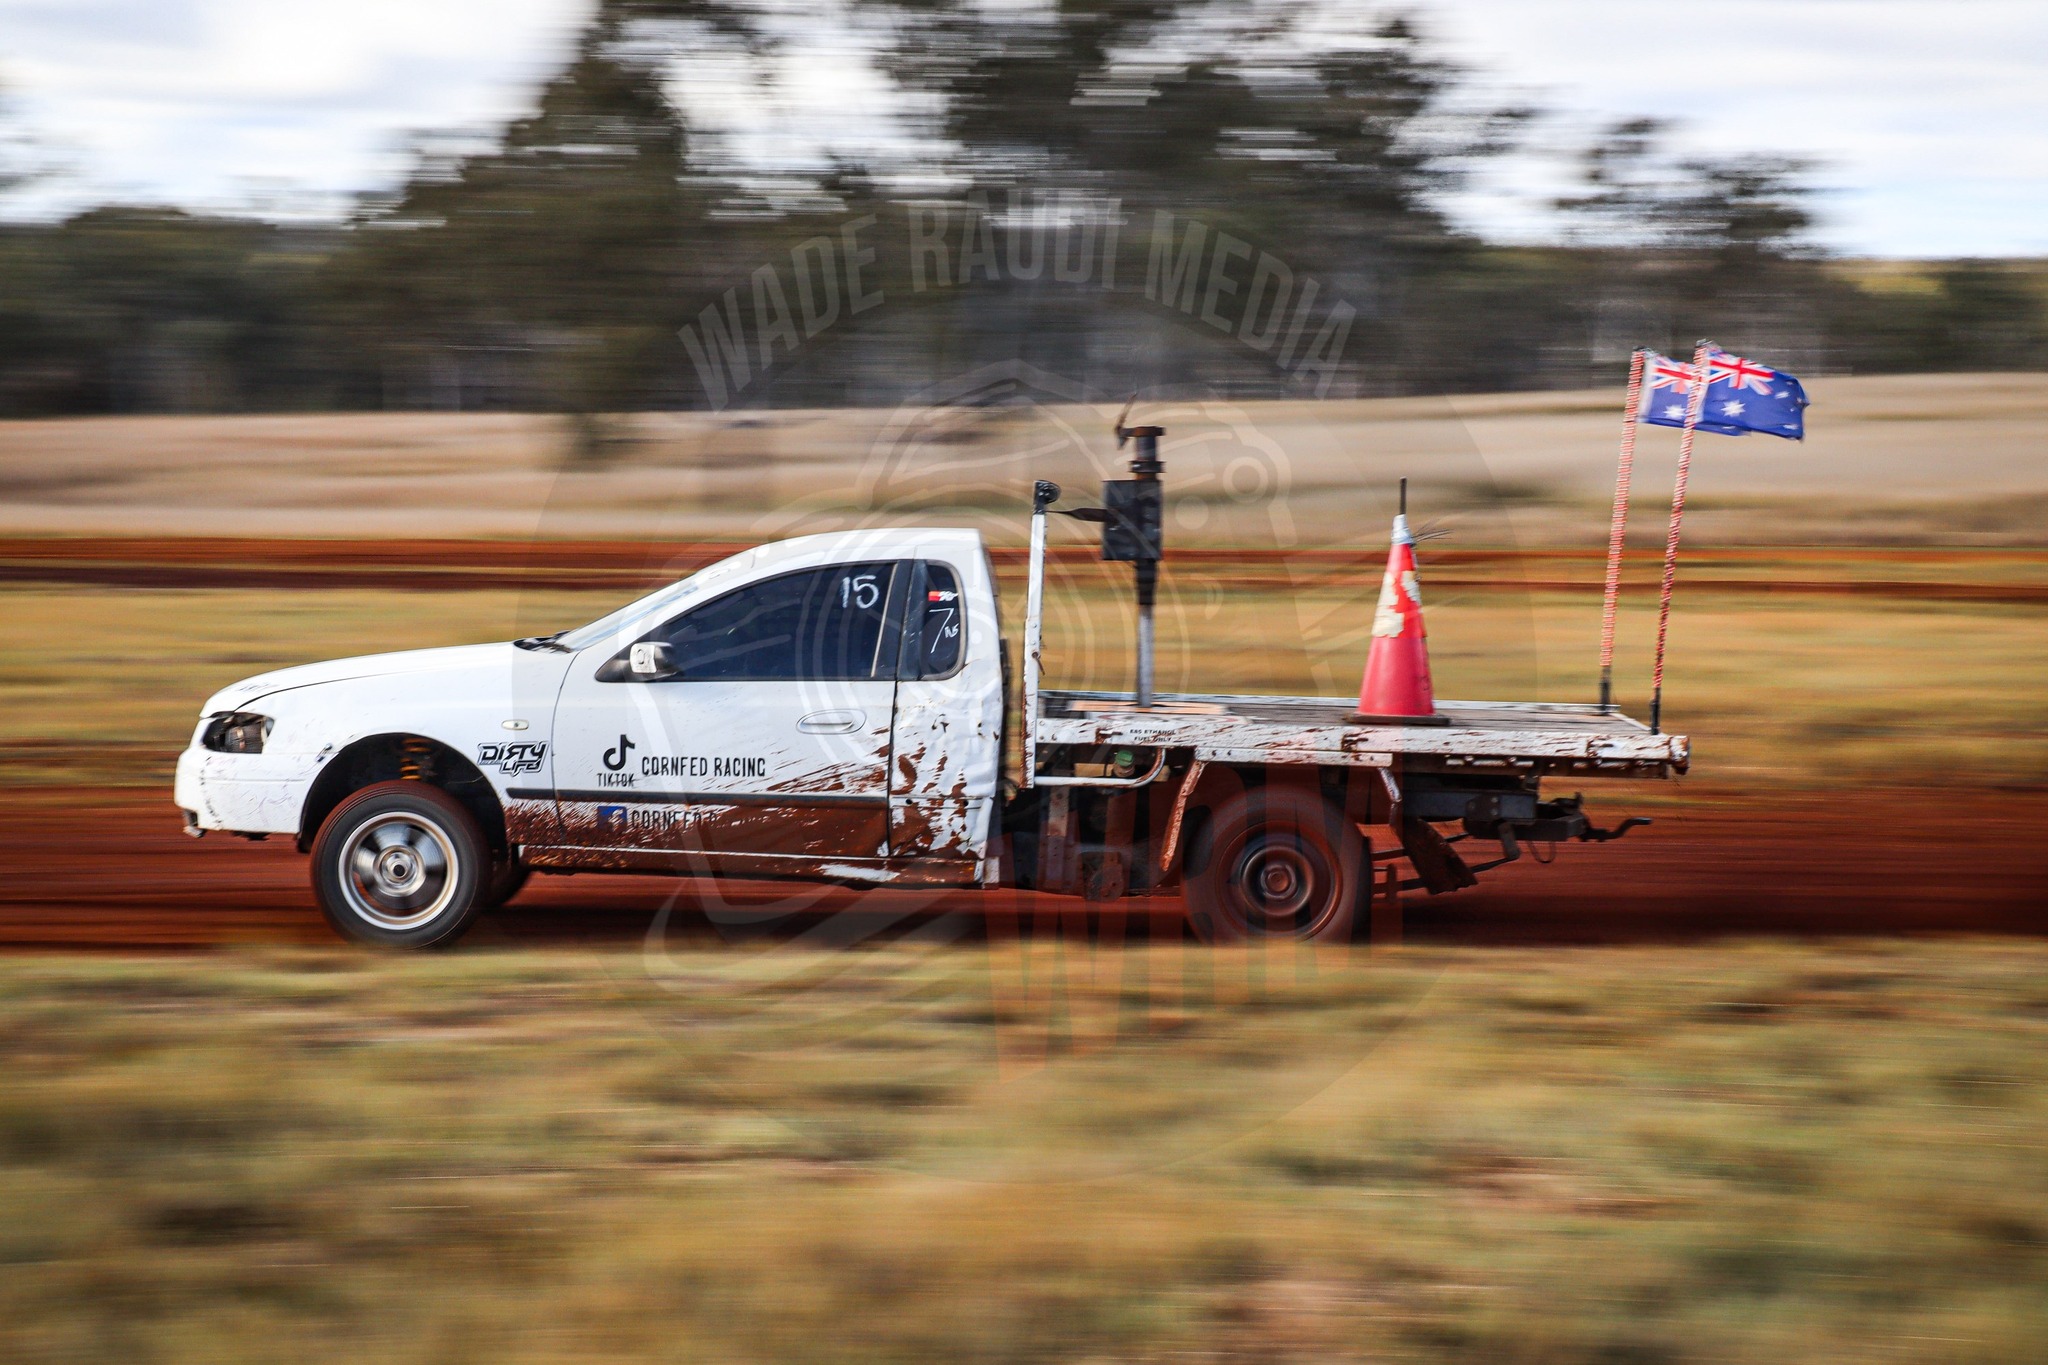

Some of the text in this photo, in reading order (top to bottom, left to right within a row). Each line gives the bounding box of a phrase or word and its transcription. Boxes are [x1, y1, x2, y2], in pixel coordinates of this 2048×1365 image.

[841, 574, 879, 609] 15
[480, 743, 548, 762] DIRTY
[641, 756, 766, 778] CORNFED RACING
[596, 772, 635, 788] TIKTOK
